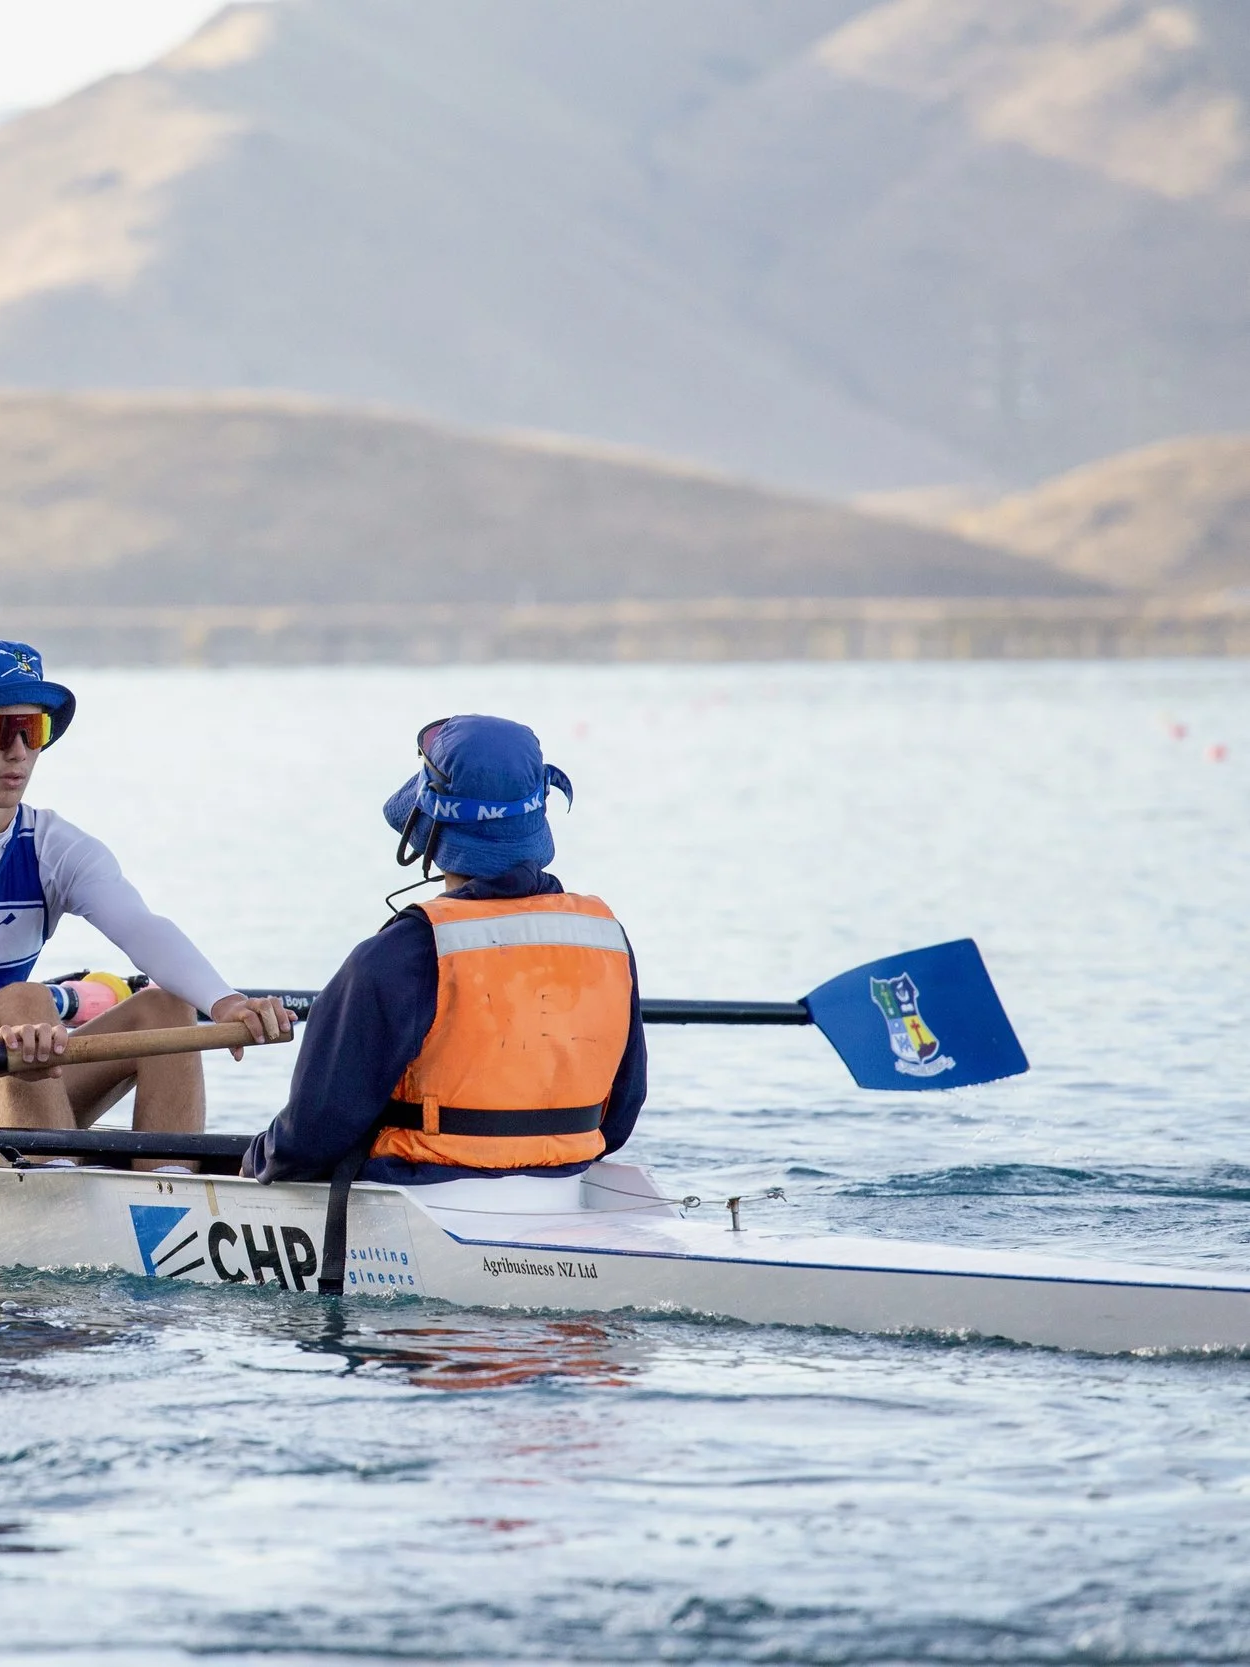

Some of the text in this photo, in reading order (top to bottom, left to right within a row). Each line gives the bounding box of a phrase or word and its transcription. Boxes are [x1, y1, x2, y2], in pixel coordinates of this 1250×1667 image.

[435, 791, 543, 821] NK NK NK
[285, 994, 308, 1009] Boys
[208, 1221, 318, 1292] CHP
[350, 1247, 408, 1265] sulting
[349, 1269, 415, 1285] gineers
[483, 1256, 598, 1279] Agribusiness NZ Ltd
